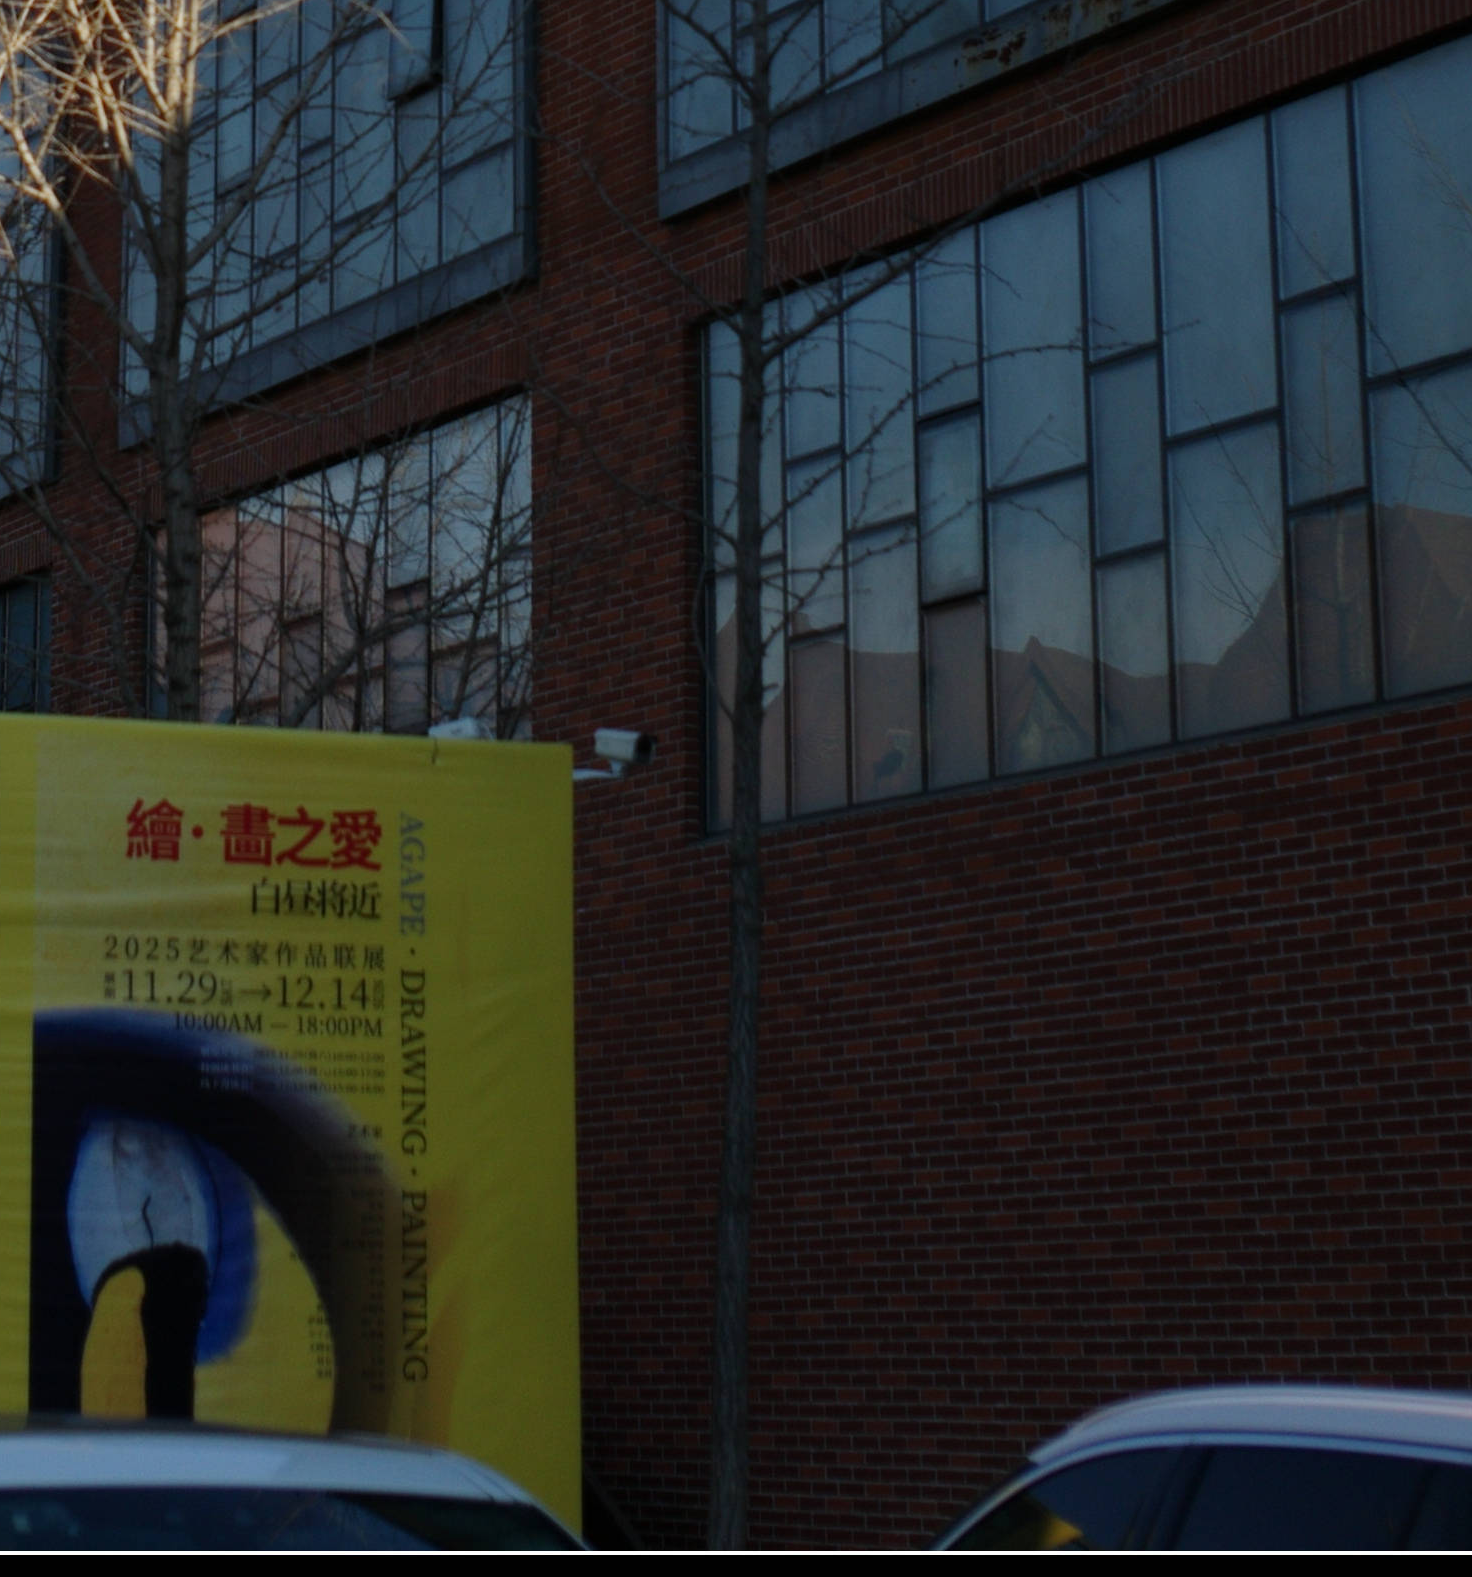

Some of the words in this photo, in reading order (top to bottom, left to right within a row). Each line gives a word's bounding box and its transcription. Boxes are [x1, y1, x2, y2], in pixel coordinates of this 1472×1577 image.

[126, 798, 382, 871] 繪·畫之愛
[399, 811, 426, 936] AGAPE
[104, 934, 386, 971] 2025艺术家作品联展
[122, 968, 217, 1004] 11.29
[278, 975, 368, 1011] 12.14
[174, 1011, 263, 1032] 10:00AM
[297, 1015, 383, 1037] 18:00PM
[401, 969, 427, 1156] DRAWING
[402, 1190, 429, 1383] PAINTING
